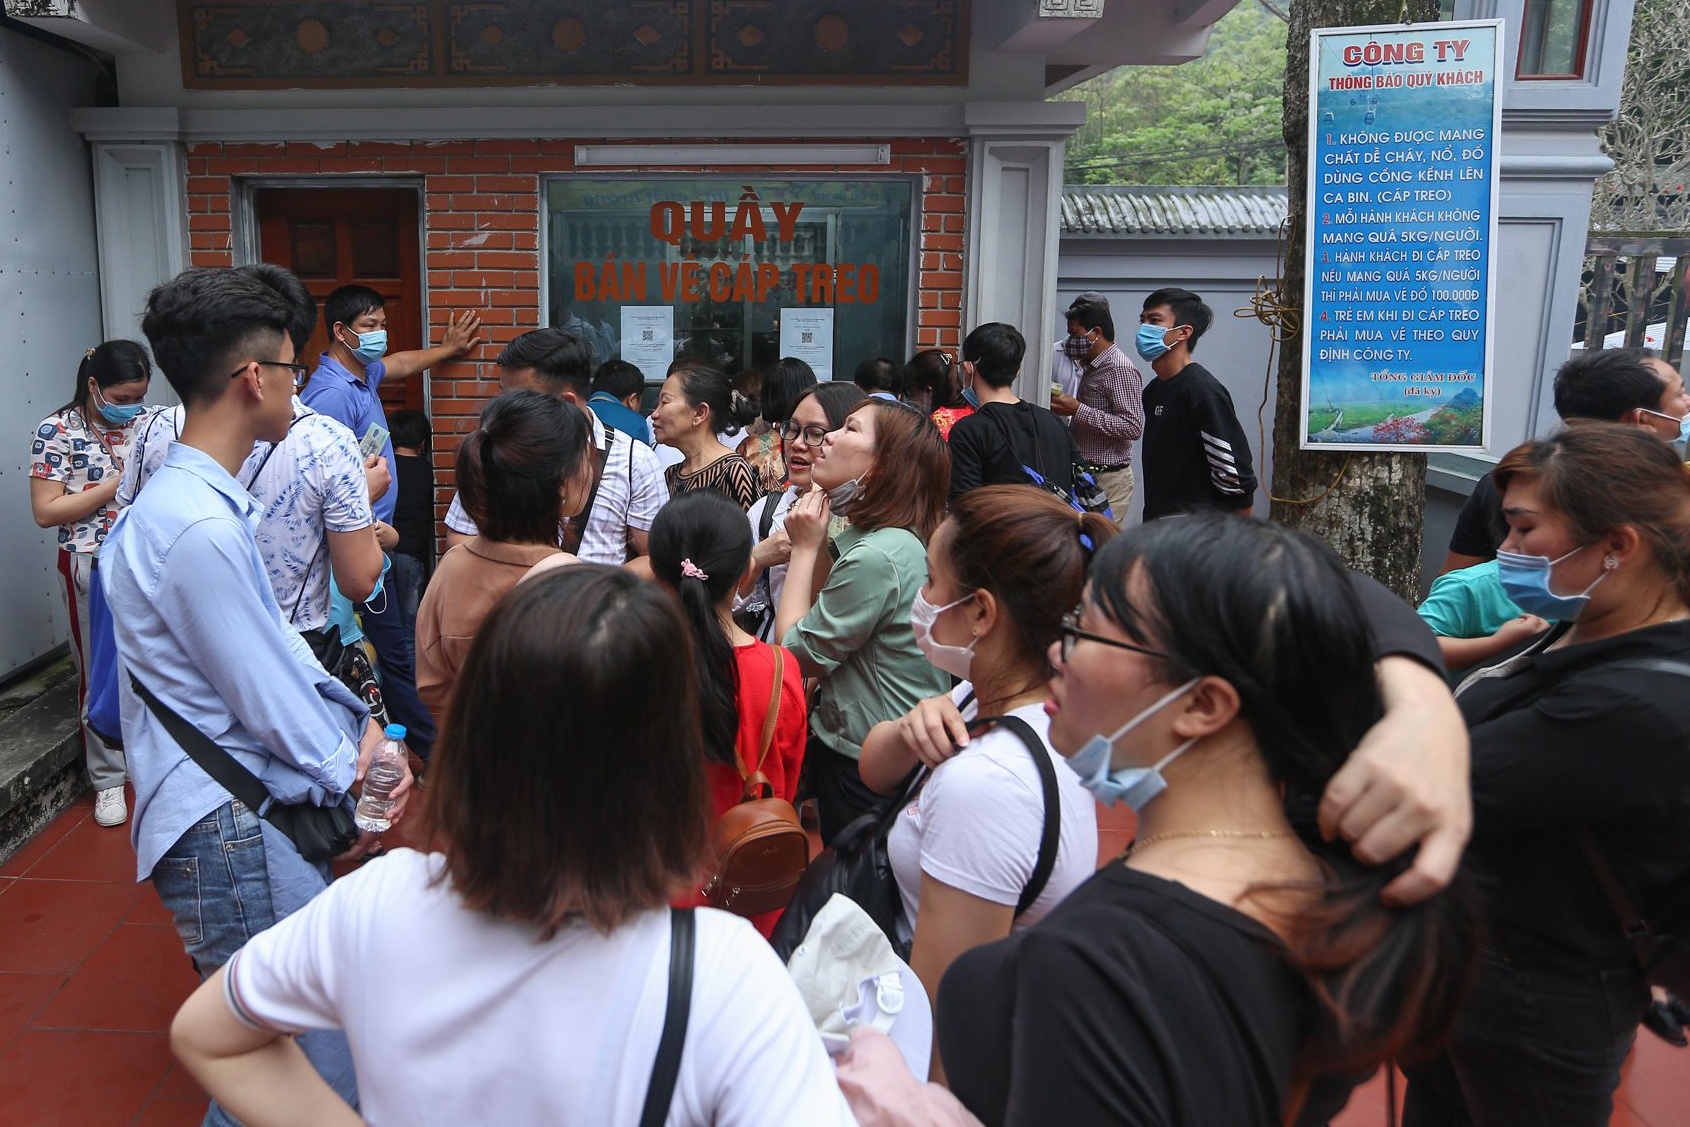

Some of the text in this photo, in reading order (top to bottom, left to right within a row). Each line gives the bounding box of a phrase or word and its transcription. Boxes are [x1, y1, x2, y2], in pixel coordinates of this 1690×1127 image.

[1343, 40, 1470, 66] CÔNG TY
[1329, 69, 1483, 90] THÔNG BÁO QUÝ KHÁCH
[1326, 129, 1485, 145] 1. KHÔNG ĐƯỢC MANG
[1325, 144, 1484, 165] CHẤT DỄ CHÁY, NỔ, ĐỒ
[1324, 166, 1483, 184] DÙNG CỒNG KỀNH LÊN
[1323, 188, 1451, 204] CA BIN. (CÁP TREO)
[651, 186, 804, 246] QUẦY
[1322, 207, 1480, 225] 2. MỖI HÀNH KHÁCH KHÔNG
[1323, 226, 1482, 244] MANG QUÁ 5KG/NGƯỜI.
[1322, 247, 1480, 263] 3. HÀNH KHÁCH ĐI CÁP TREO
[574, 252, 879, 304] BÁN VÉ CÁP TREO
[1321, 266, 1480, 282] NẾU MANG QUÁ 5KG/NGƯỜI
[1321, 290, 1336, 302] THÌ
[1339, 288, 1363, 302] PHẢI
[1366, 290, 1390, 301] MUA
[1394, 287, 1406, 301] VÉ
[1432, 290, 1479, 301] 100.000Đ
[1320, 306, 1479, 321] 4. TRẺ EM KHI ĐI CÁP TREO
[1320, 326, 1479, 341] PHẢI MUA VÉ THEO QUY
[1319, 348, 1413, 363] ĐỊNH CÔNG TY.
[1371, 369, 1476, 382] TỔNG GIÁM ĐỐC
[1404, 386, 1441, 398] (đã ký)
